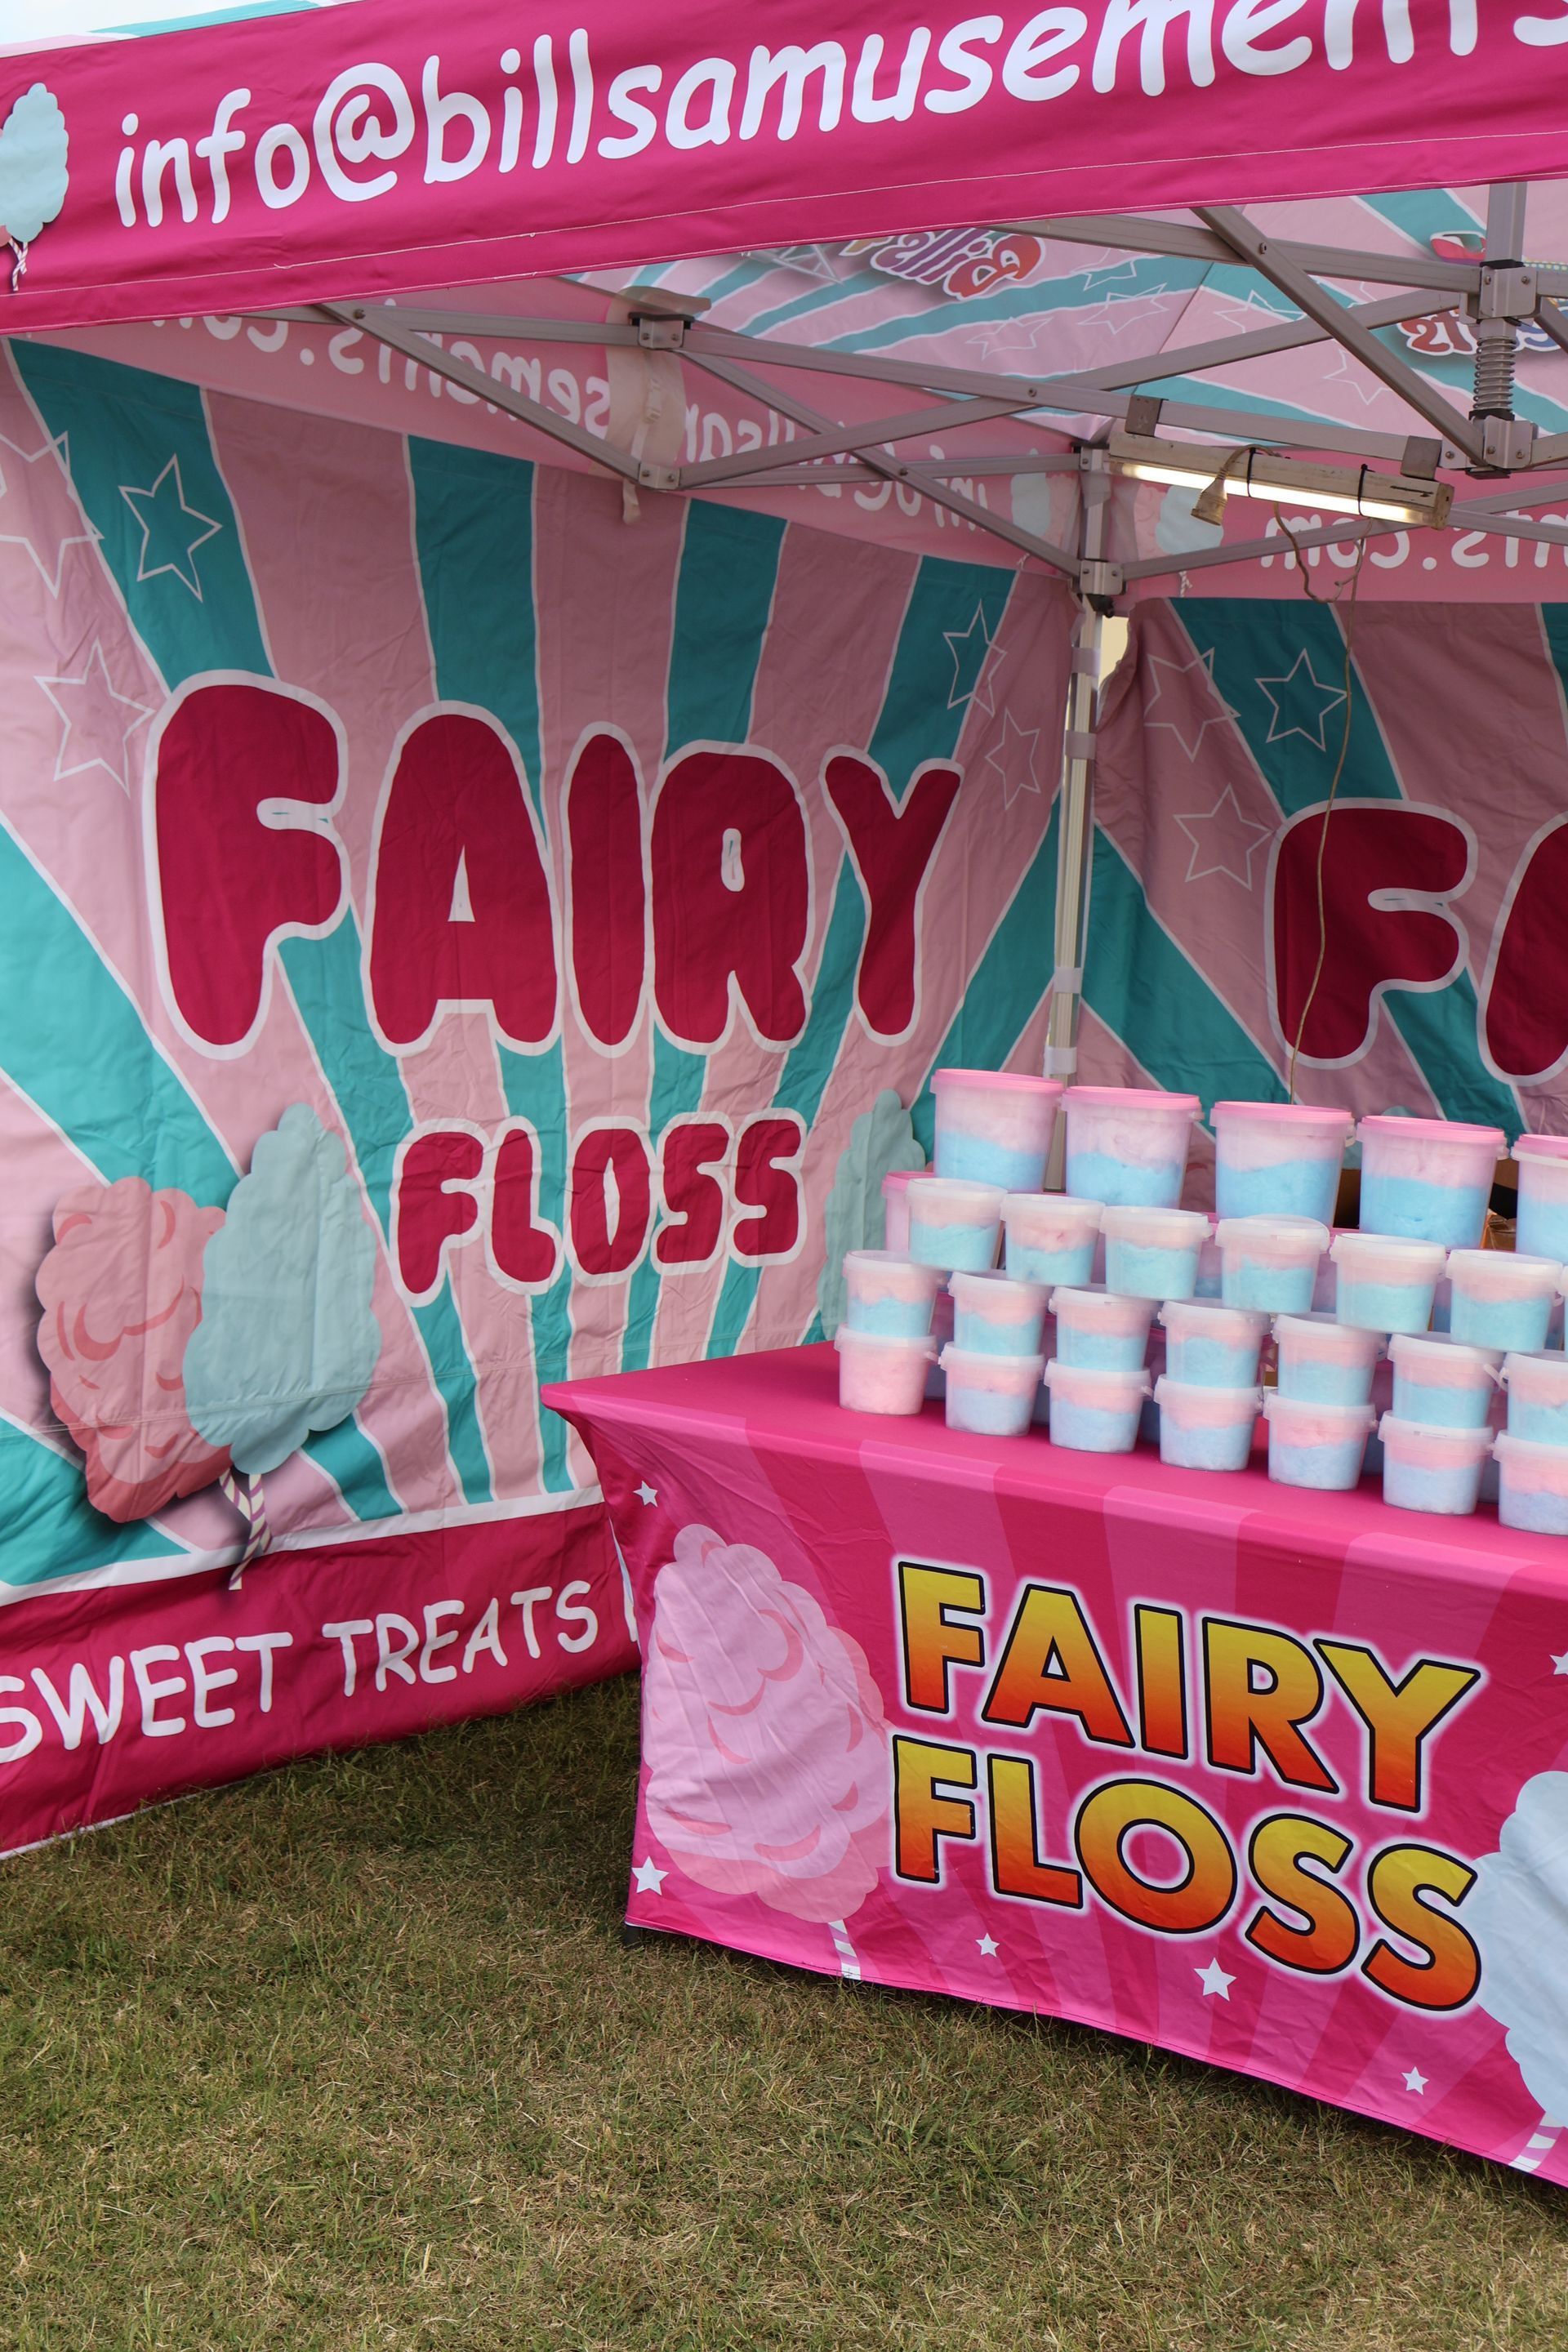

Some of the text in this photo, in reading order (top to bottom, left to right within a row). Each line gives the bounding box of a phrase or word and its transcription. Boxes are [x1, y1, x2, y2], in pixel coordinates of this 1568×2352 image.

[142, 670, 965, 1060] FAIRY
[390, 1107, 808, 1307] FLOSS
[0, 1632, 293, 1764] SWEET
[322, 1580, 599, 1698] TREATS
[896, 1560, 1482, 1815] FAIRY
[892, 1733, 1483, 2013] FLOSS
